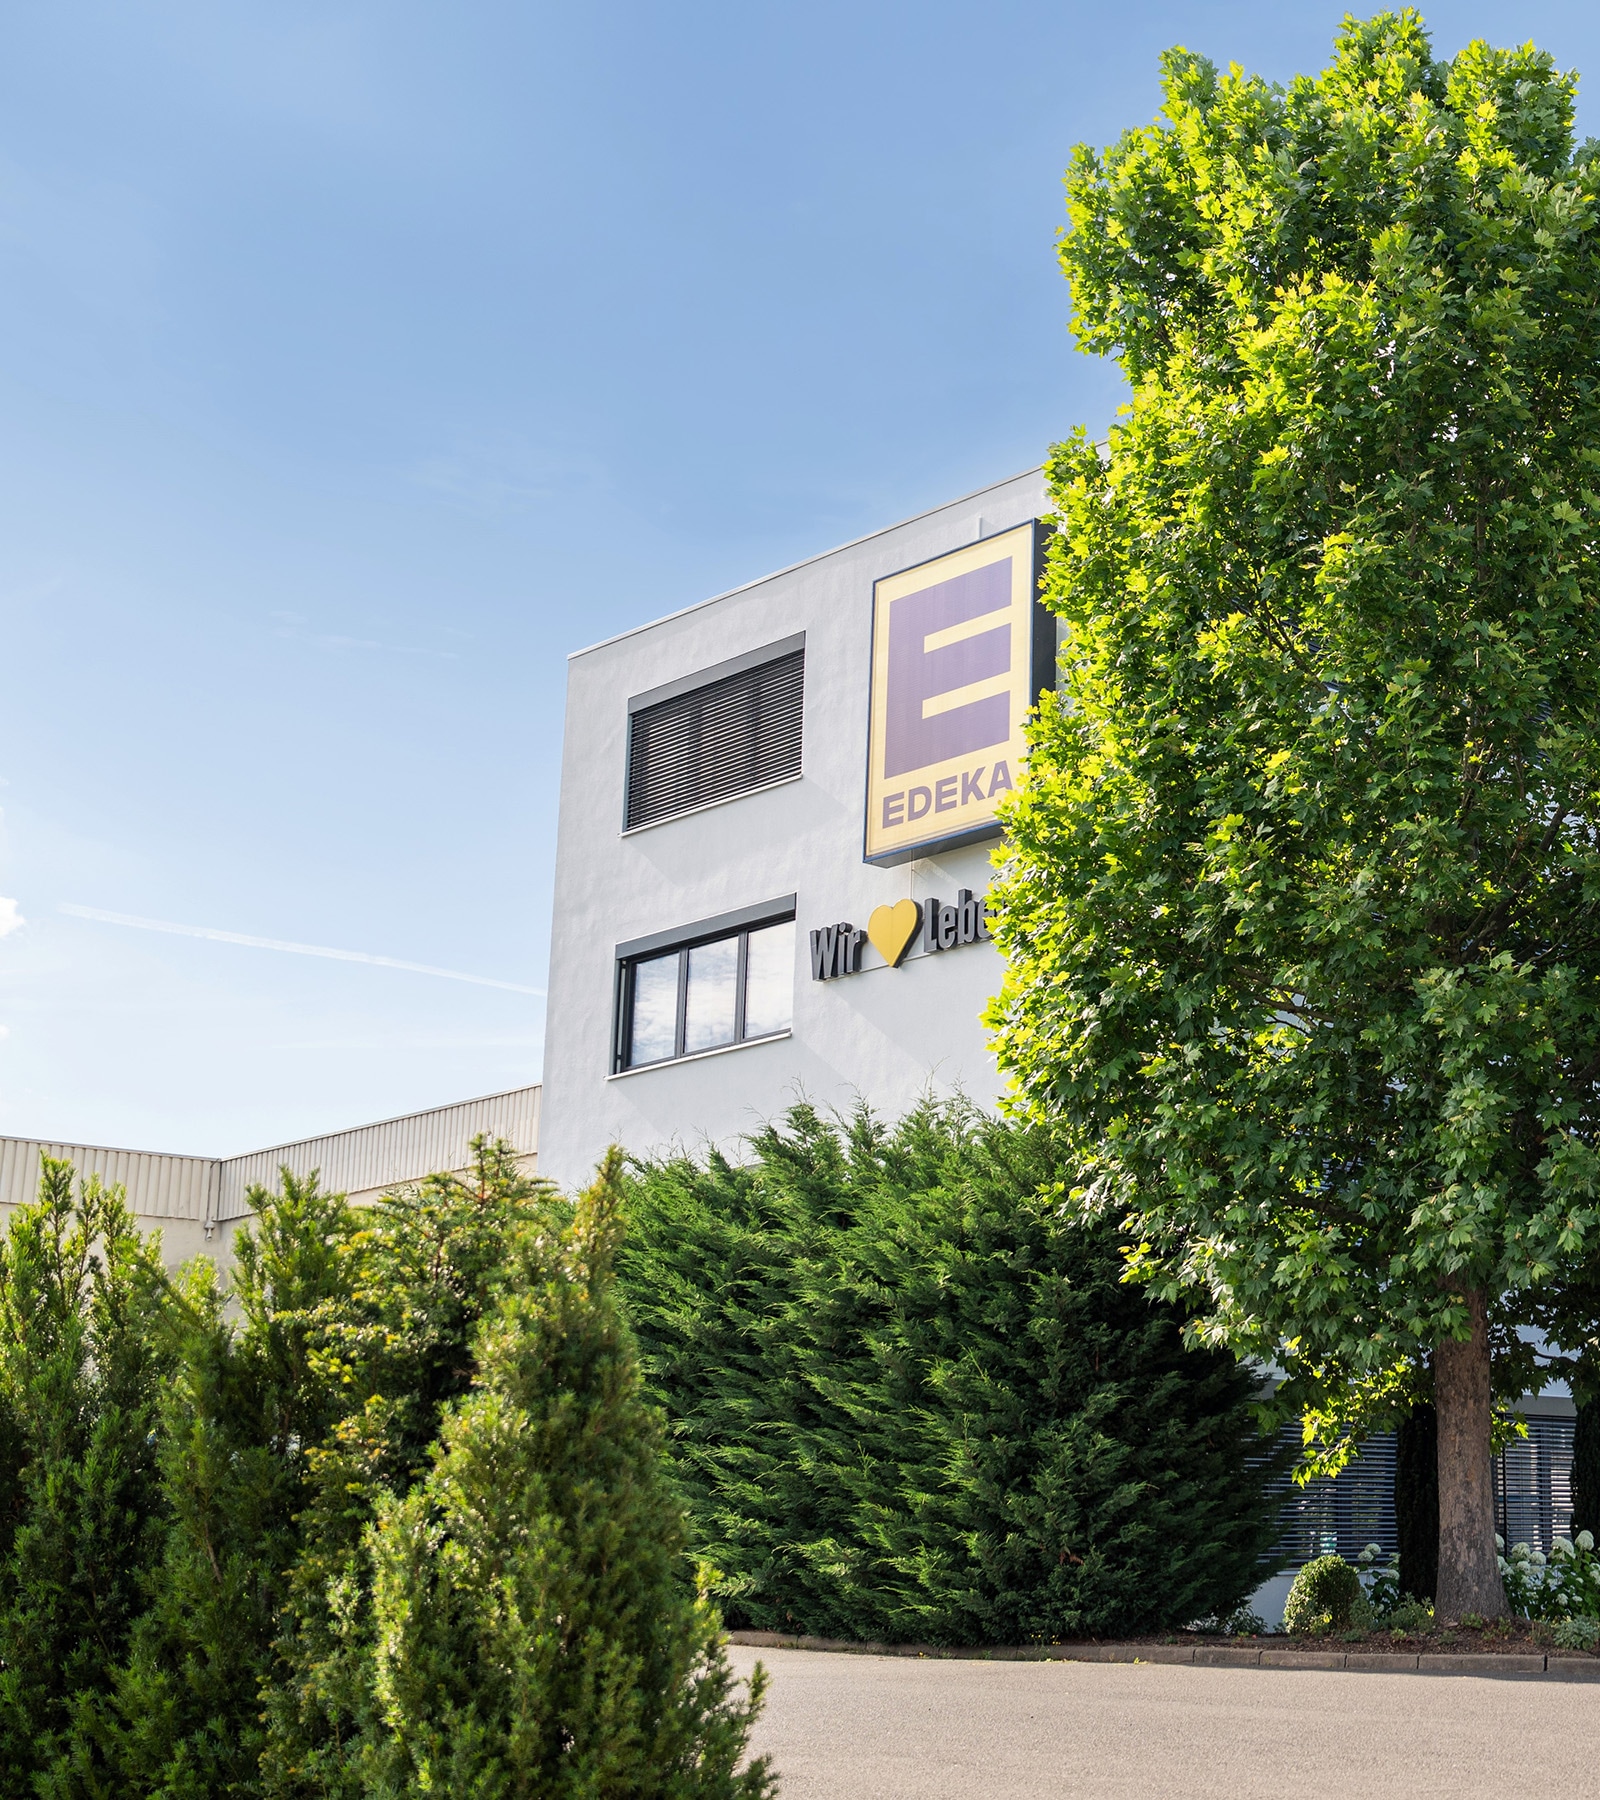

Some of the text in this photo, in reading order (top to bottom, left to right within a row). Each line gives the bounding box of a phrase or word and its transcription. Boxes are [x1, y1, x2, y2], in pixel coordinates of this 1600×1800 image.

[884, 556, 1013, 780] E
[882, 760, 1013, 829] EDEKA
[810, 888, 1005, 981] Wir Lebe
